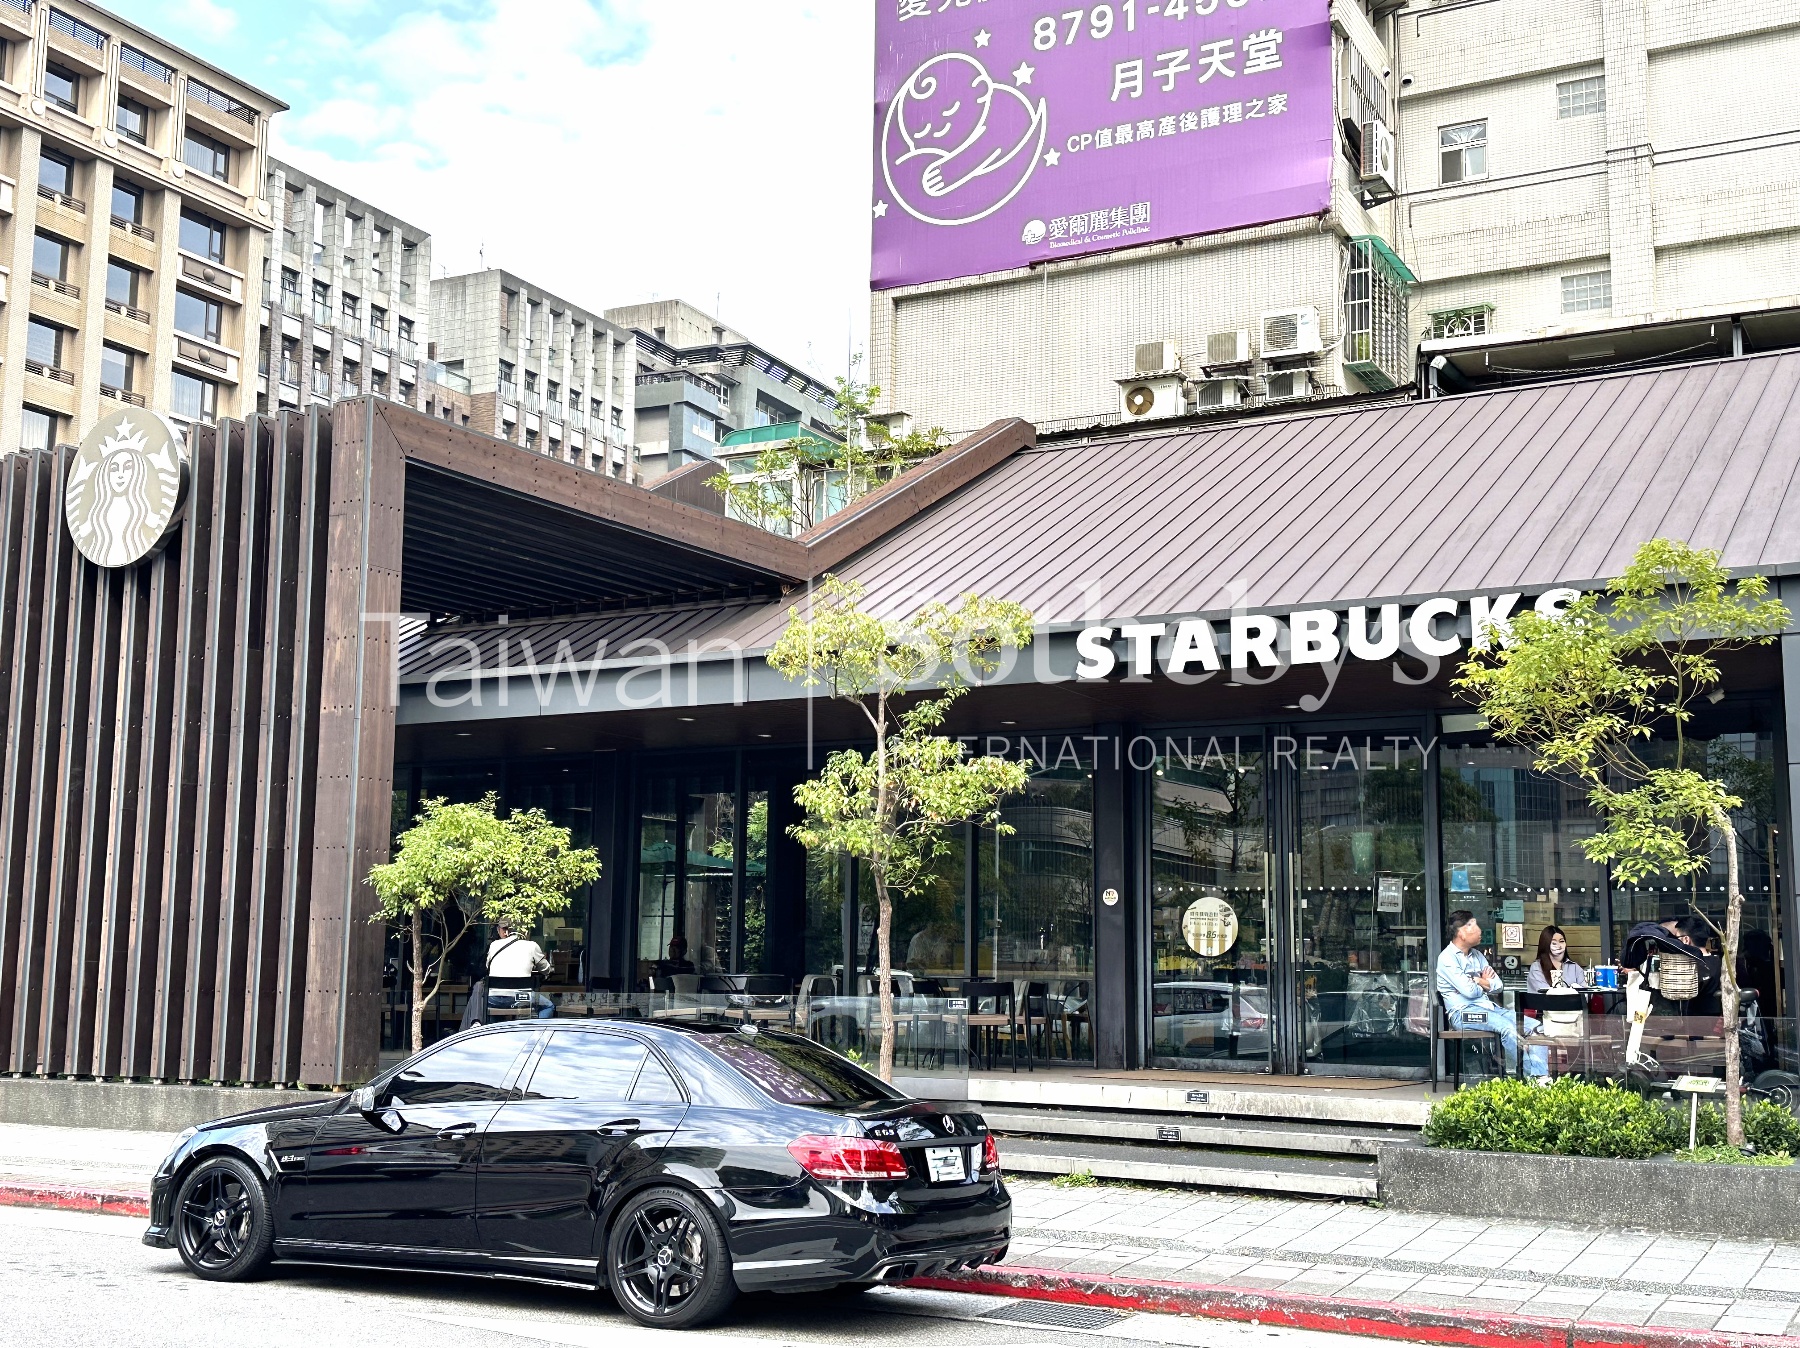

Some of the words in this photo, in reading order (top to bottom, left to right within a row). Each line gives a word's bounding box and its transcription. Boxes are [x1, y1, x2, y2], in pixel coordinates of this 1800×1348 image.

[1034, 0, 1266, 50] 8791-4
[1110, 28, 1284, 102] 月子天堂
[1067, 93, 1288, 152] CP值最高產後護理之家
[1048, 201, 1151, 240] 愛爾麗集團
